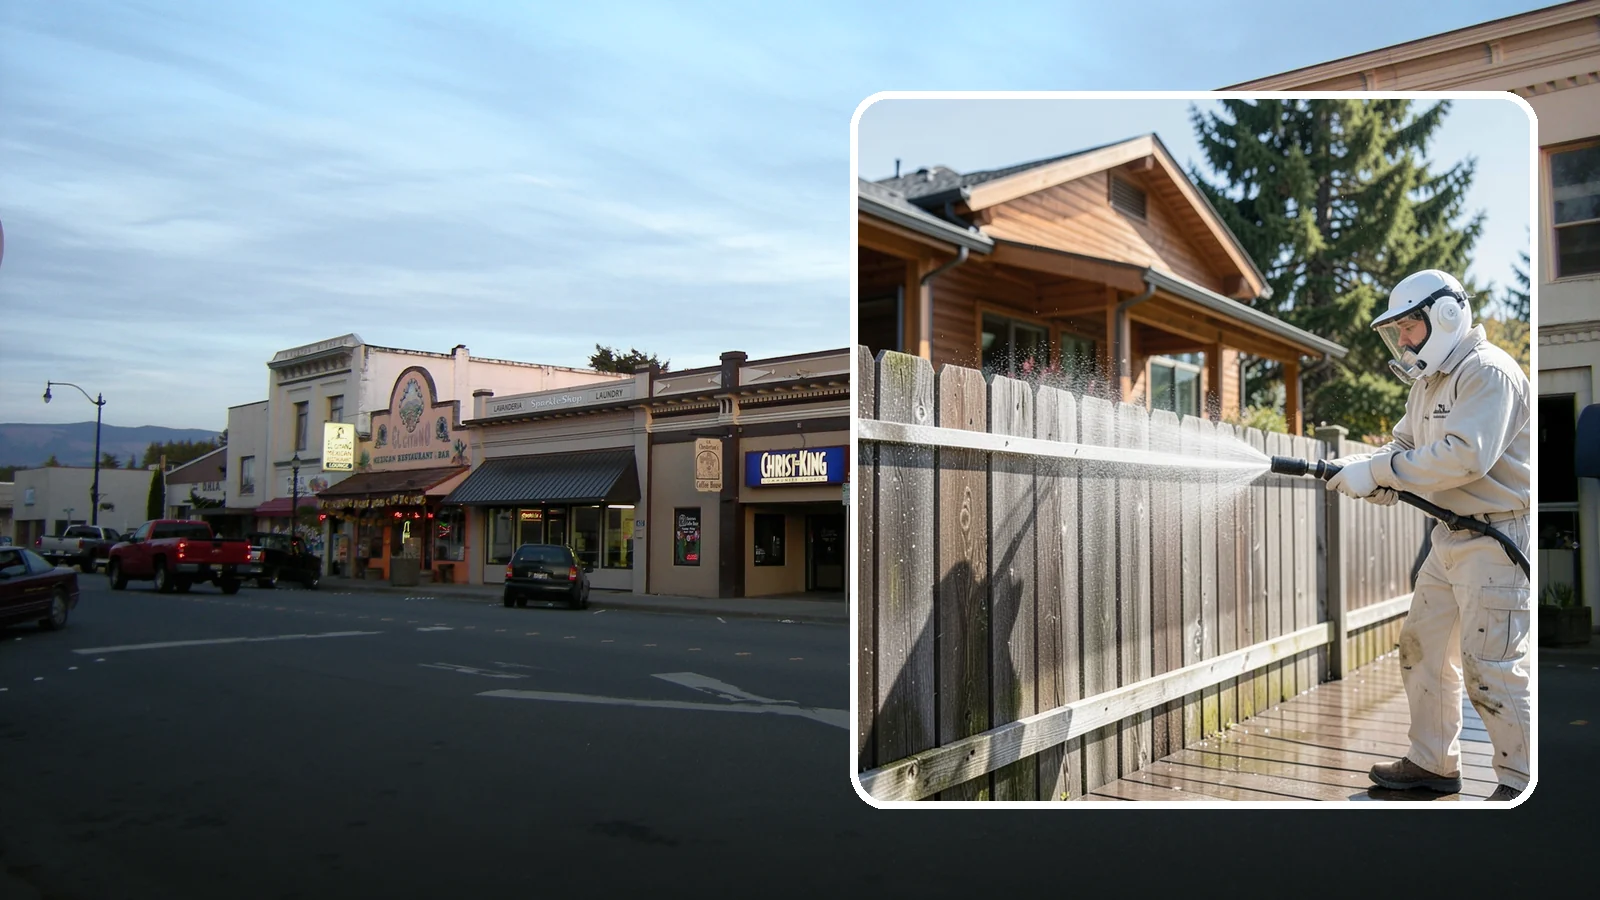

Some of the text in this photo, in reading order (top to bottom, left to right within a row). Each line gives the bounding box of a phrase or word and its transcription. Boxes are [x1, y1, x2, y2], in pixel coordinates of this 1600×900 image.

[530, 394, 583, 408] Sparkle Shop
[596, 389, 623, 399] LAUNDRY
[493, 402, 523, 412] LAVANDERIA
[402, 421, 431, 449] GITANO
[373, 454, 397, 464] MEXICAN
[397, 451, 434, 462] RESTAURANT
[437, 450, 450, 459] BAR
[761, 450, 827, 478] CHRIST KING
[696, 480, 721, 489] Coffee House
